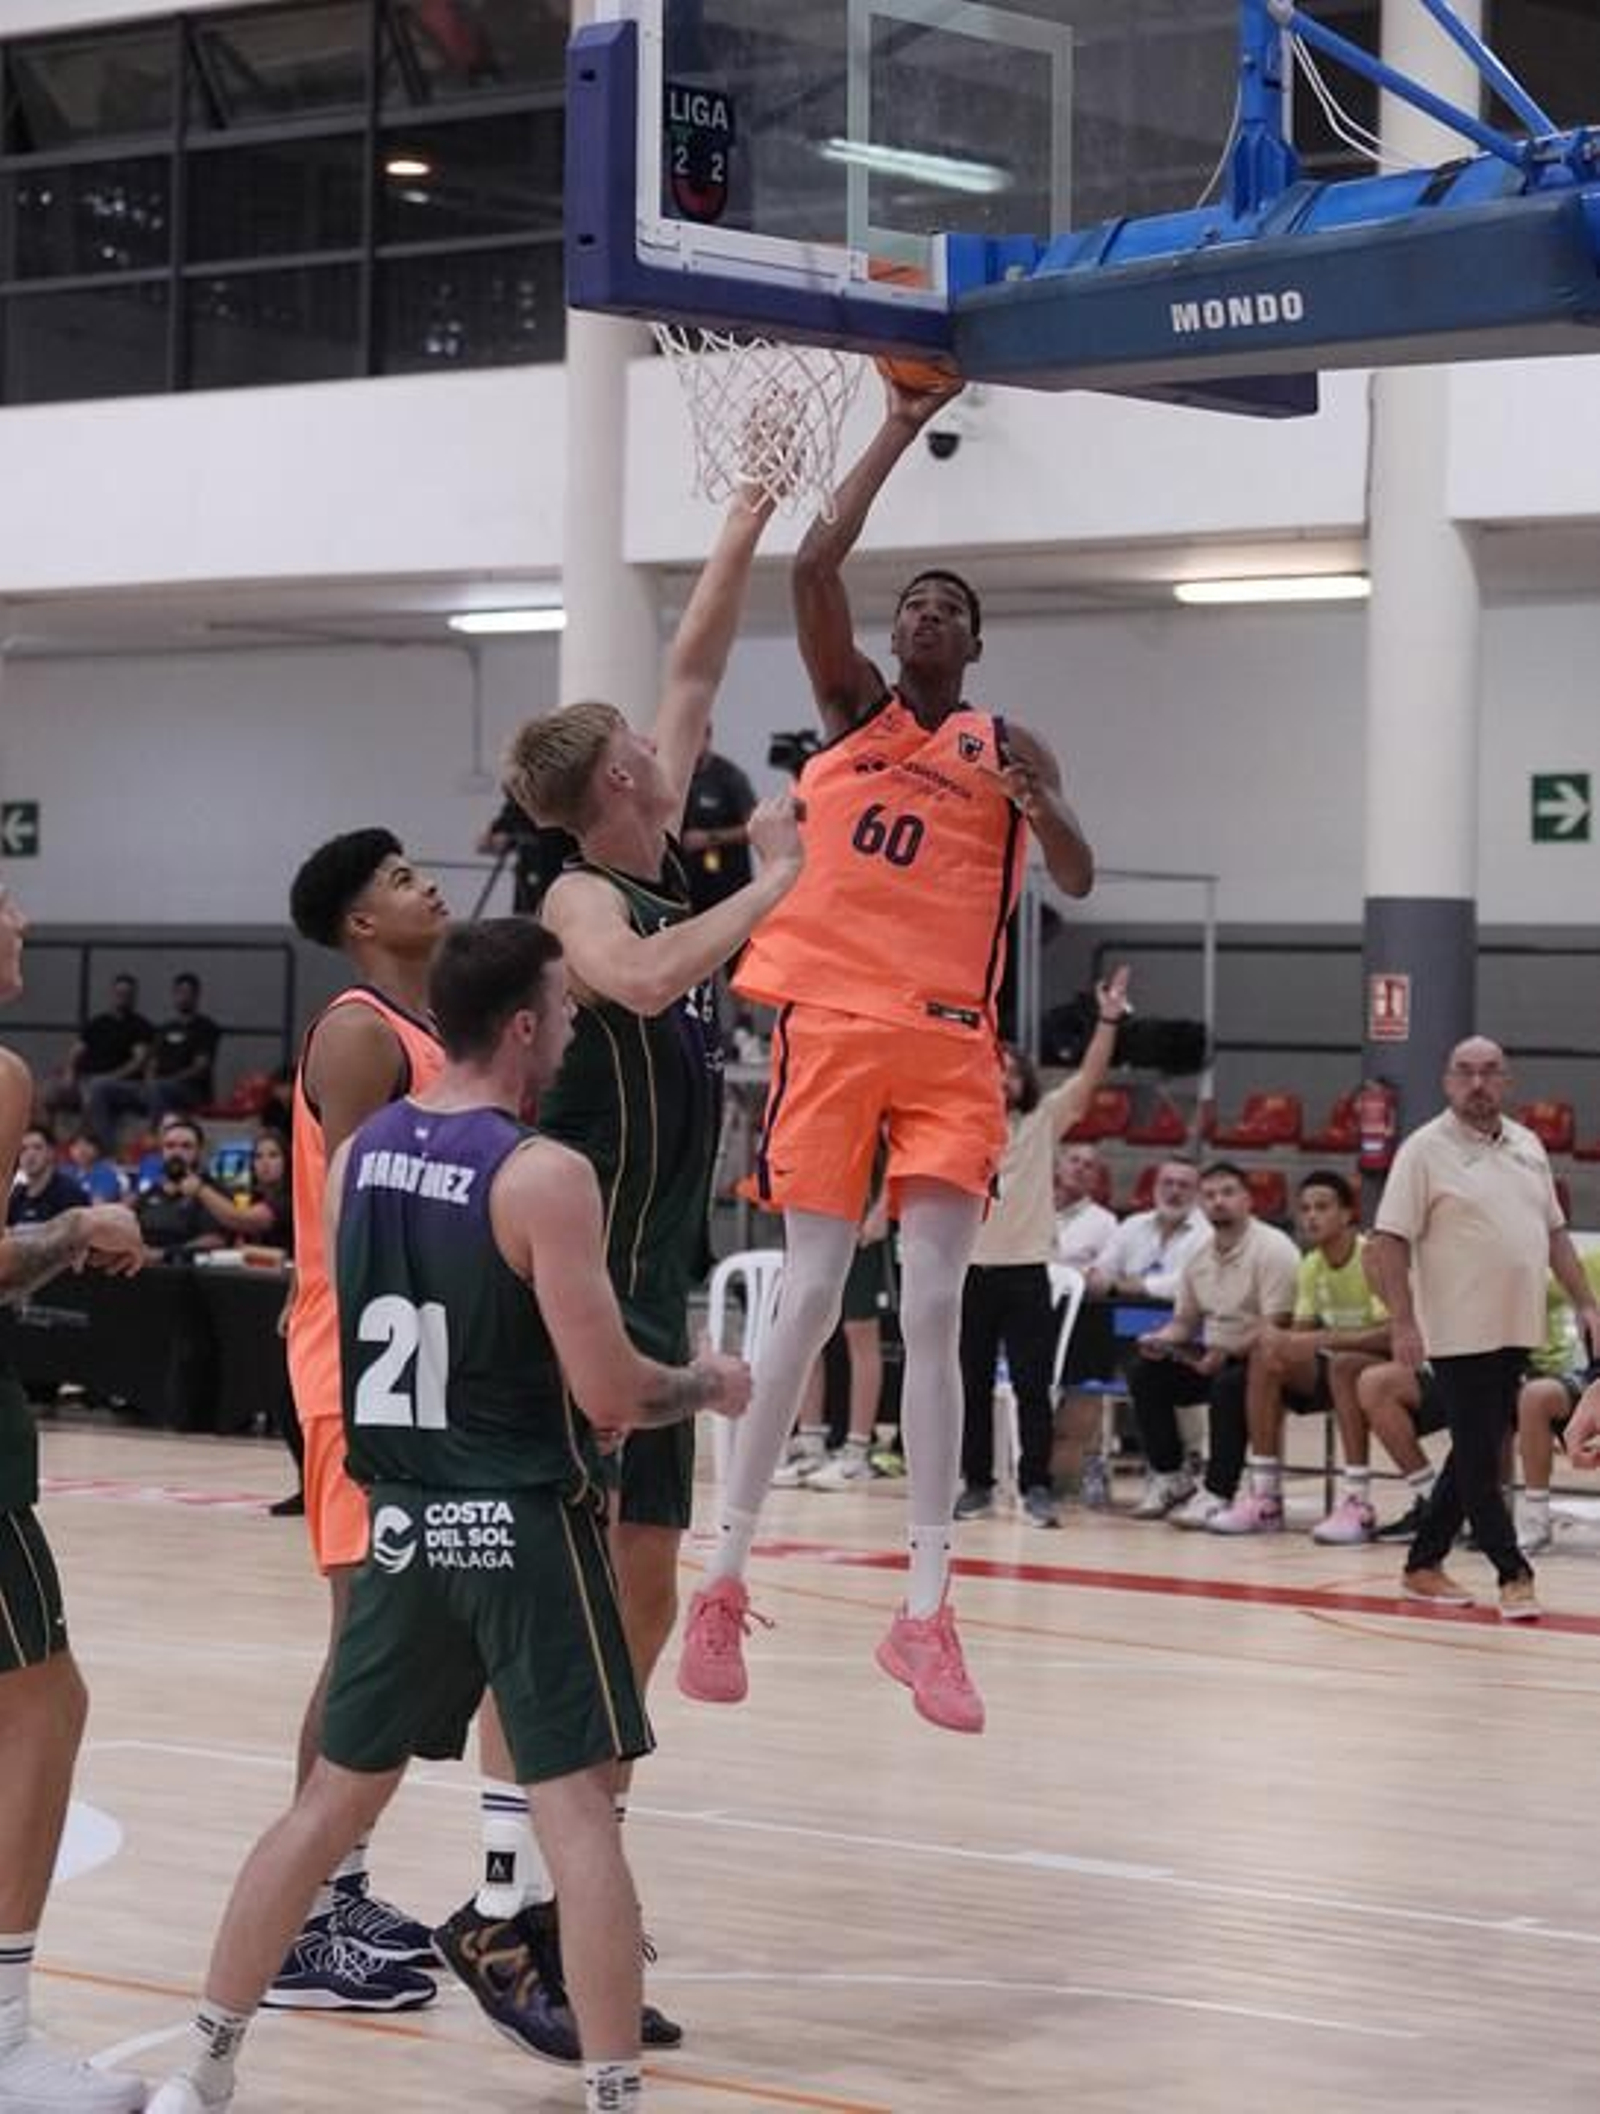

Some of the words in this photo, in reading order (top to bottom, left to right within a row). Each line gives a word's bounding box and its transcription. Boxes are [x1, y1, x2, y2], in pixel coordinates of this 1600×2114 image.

[670, 92, 728, 130] LIGA
[1170, 290, 1304, 333] MONDO
[852, 803, 925, 867] 60
[357, 1149, 476, 1206] MARTNEZ
[354, 1292, 449, 1430] 21
[425, 1502, 514, 1526] COSTA
[425, 1528, 465, 1548] DEL
[468, 1527, 516, 1547] SOL
